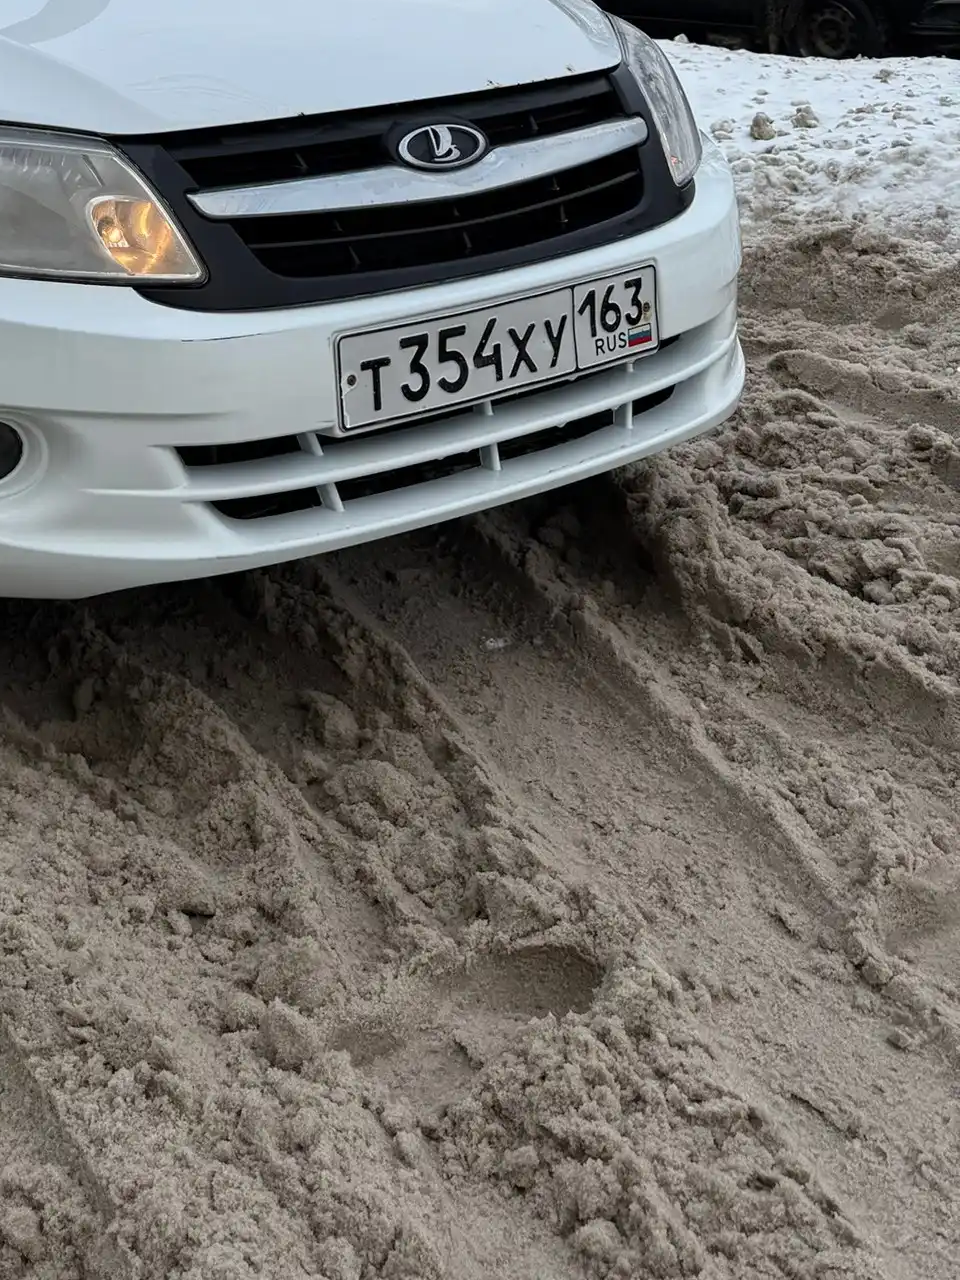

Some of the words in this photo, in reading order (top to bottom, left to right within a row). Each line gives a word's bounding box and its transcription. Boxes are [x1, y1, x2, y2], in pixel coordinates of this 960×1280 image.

[360, 314, 568, 412] Т354ХУ
[577, 277, 643, 338] 163
[595, 331, 627, 356] RUS
